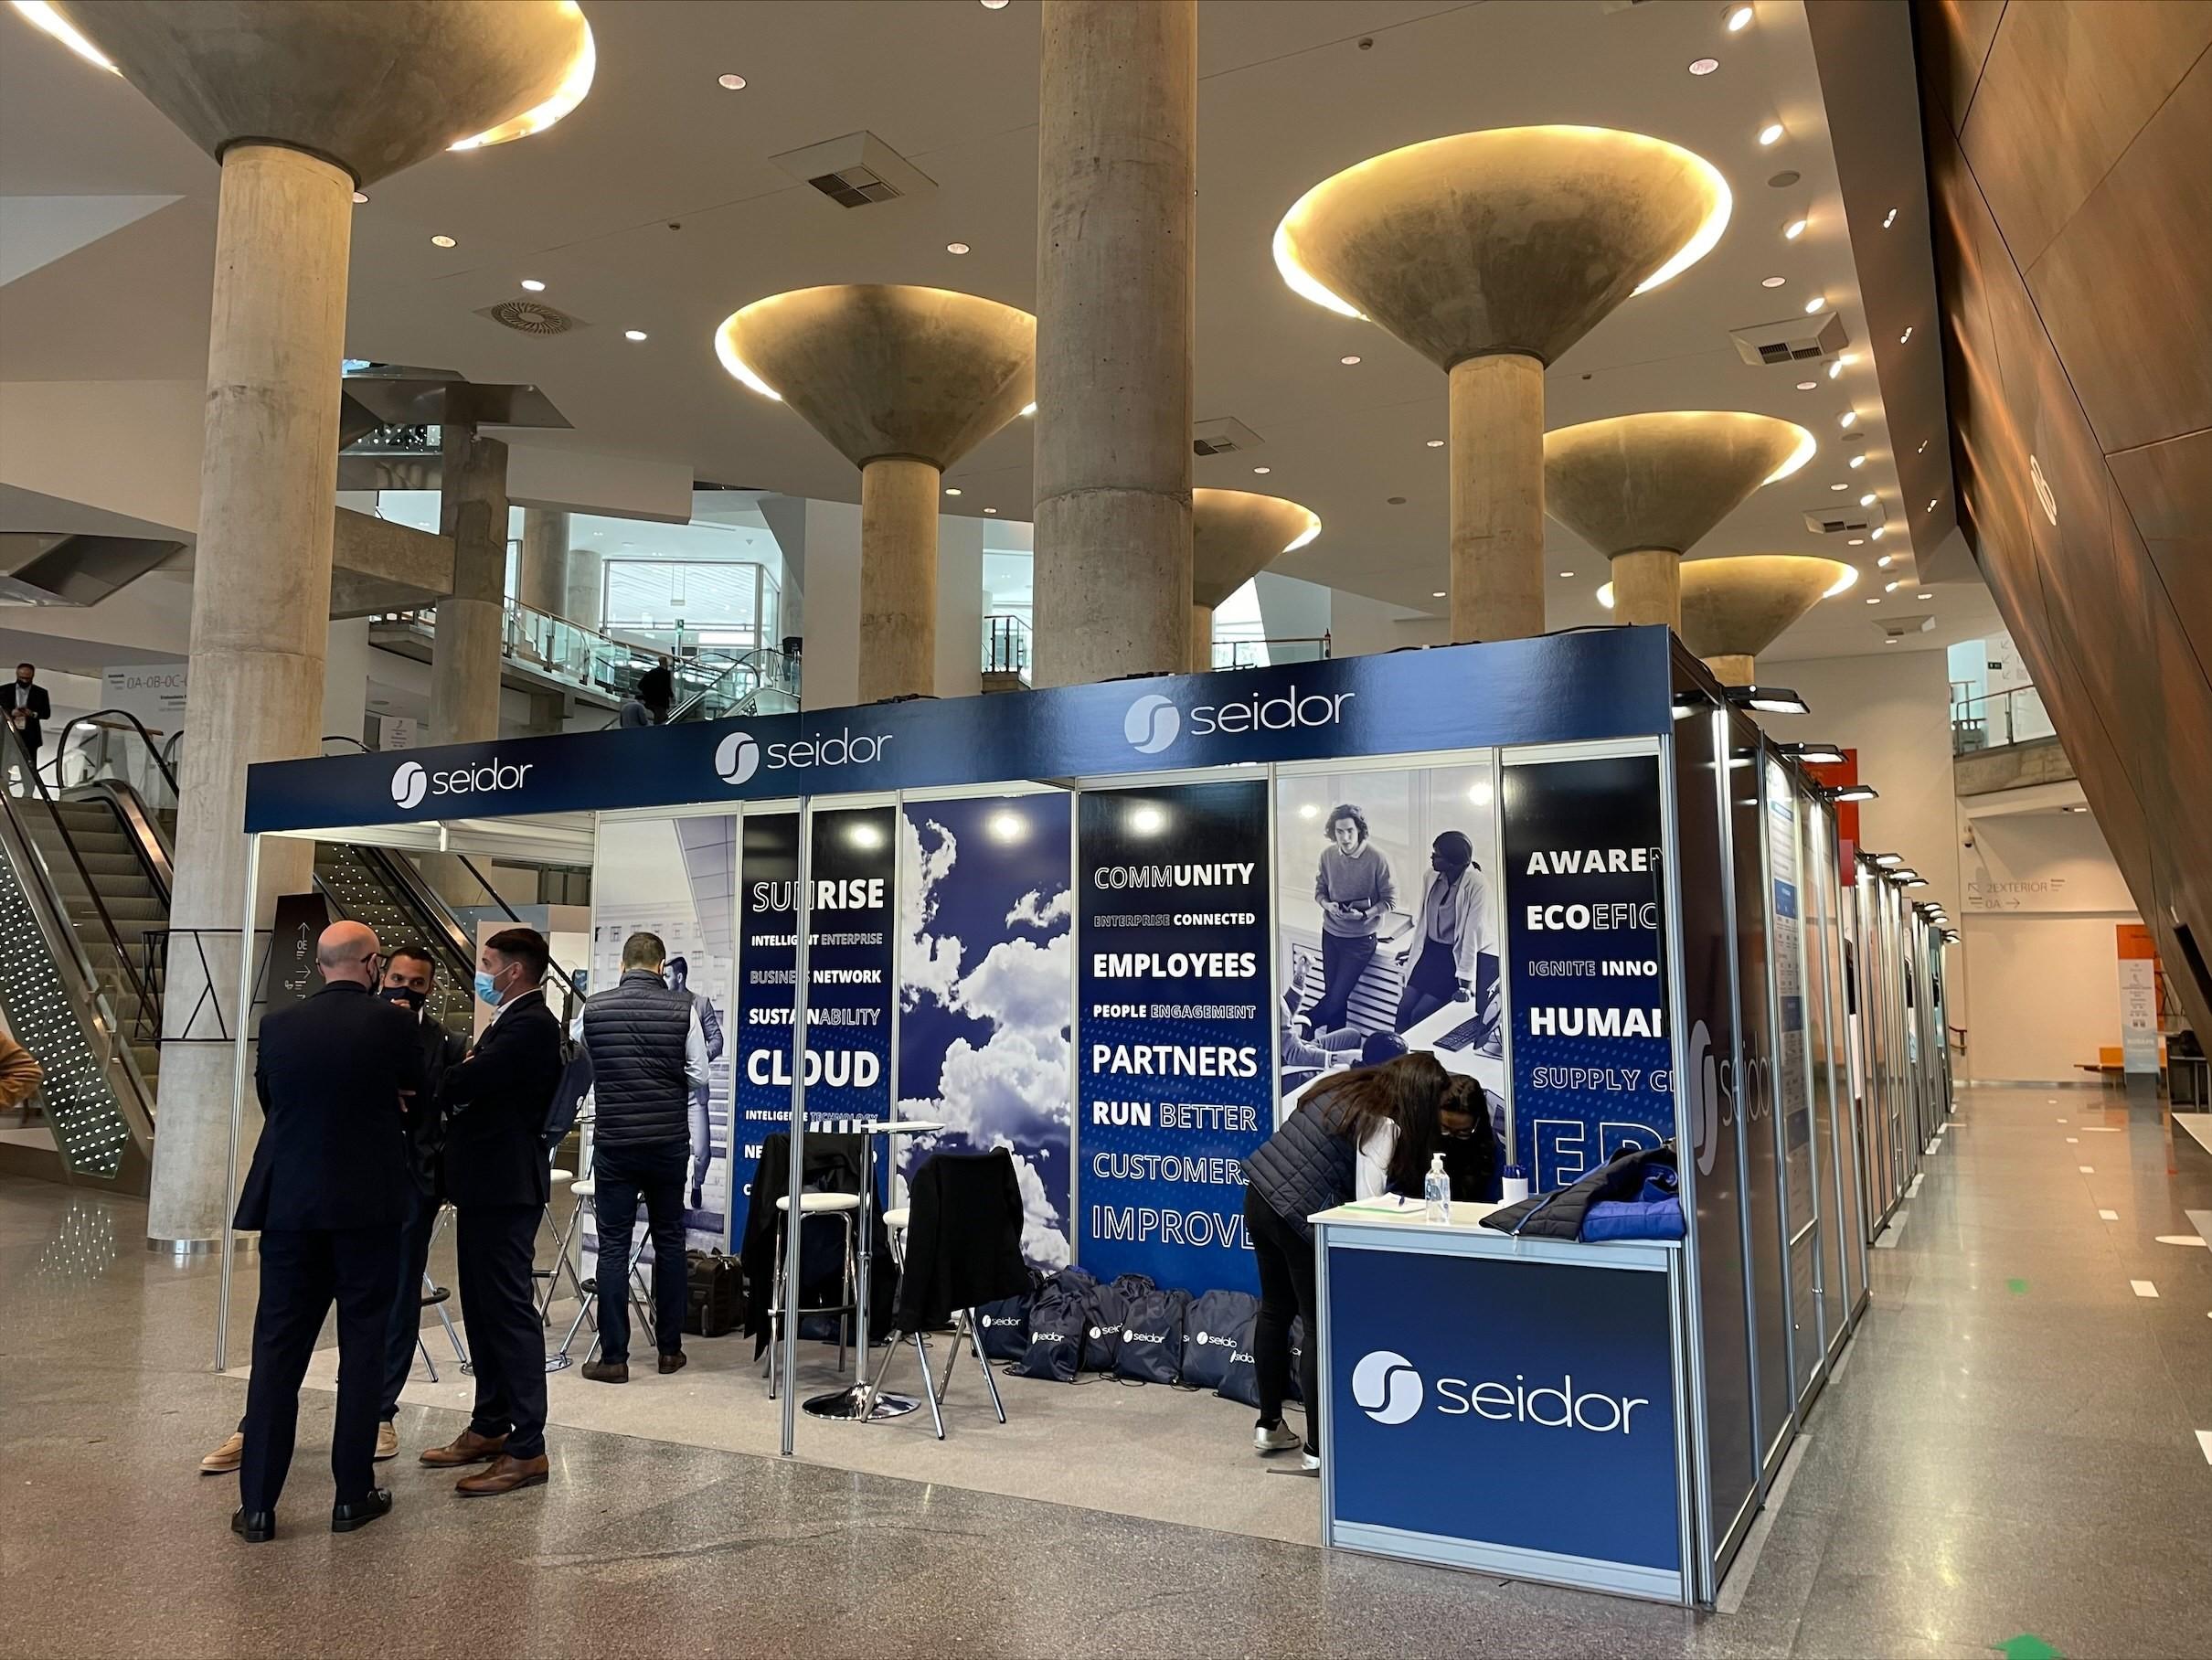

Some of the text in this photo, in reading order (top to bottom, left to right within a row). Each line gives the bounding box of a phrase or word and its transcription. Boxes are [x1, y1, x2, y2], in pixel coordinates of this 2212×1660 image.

[1190, 685, 1356, 735] seidor
[767, 727, 893, 769] seidor
[431, 757, 533, 795] seidor
[1094, 863, 1255, 889] COMMUNITY
[1093, 913, 1256, 928] ENTERPRISE CONNECTED
[1526, 902, 1659, 931] ECOEFIC
[751, 933, 883, 946] INTELLIGNT ENTERPRISE
[813, 970, 882, 984] NETWORK
[1093, 952, 1257, 978] EMPLOYEES
[1529, 961, 1658, 976] IGNITE INNO
[1093, 1005, 1257, 1019] PEOPLE ENGAGEMENT
[1093, 1044, 1258, 1078] PARTNERS
[1533, 1067, 1641, 1091] SUPPLY
[1093, 1101, 1258, 1132] RUN BETTER
[1093, 1152, 1250, 1186] CUSTOMER
[1436, 1374, 1649, 1434] seidor
